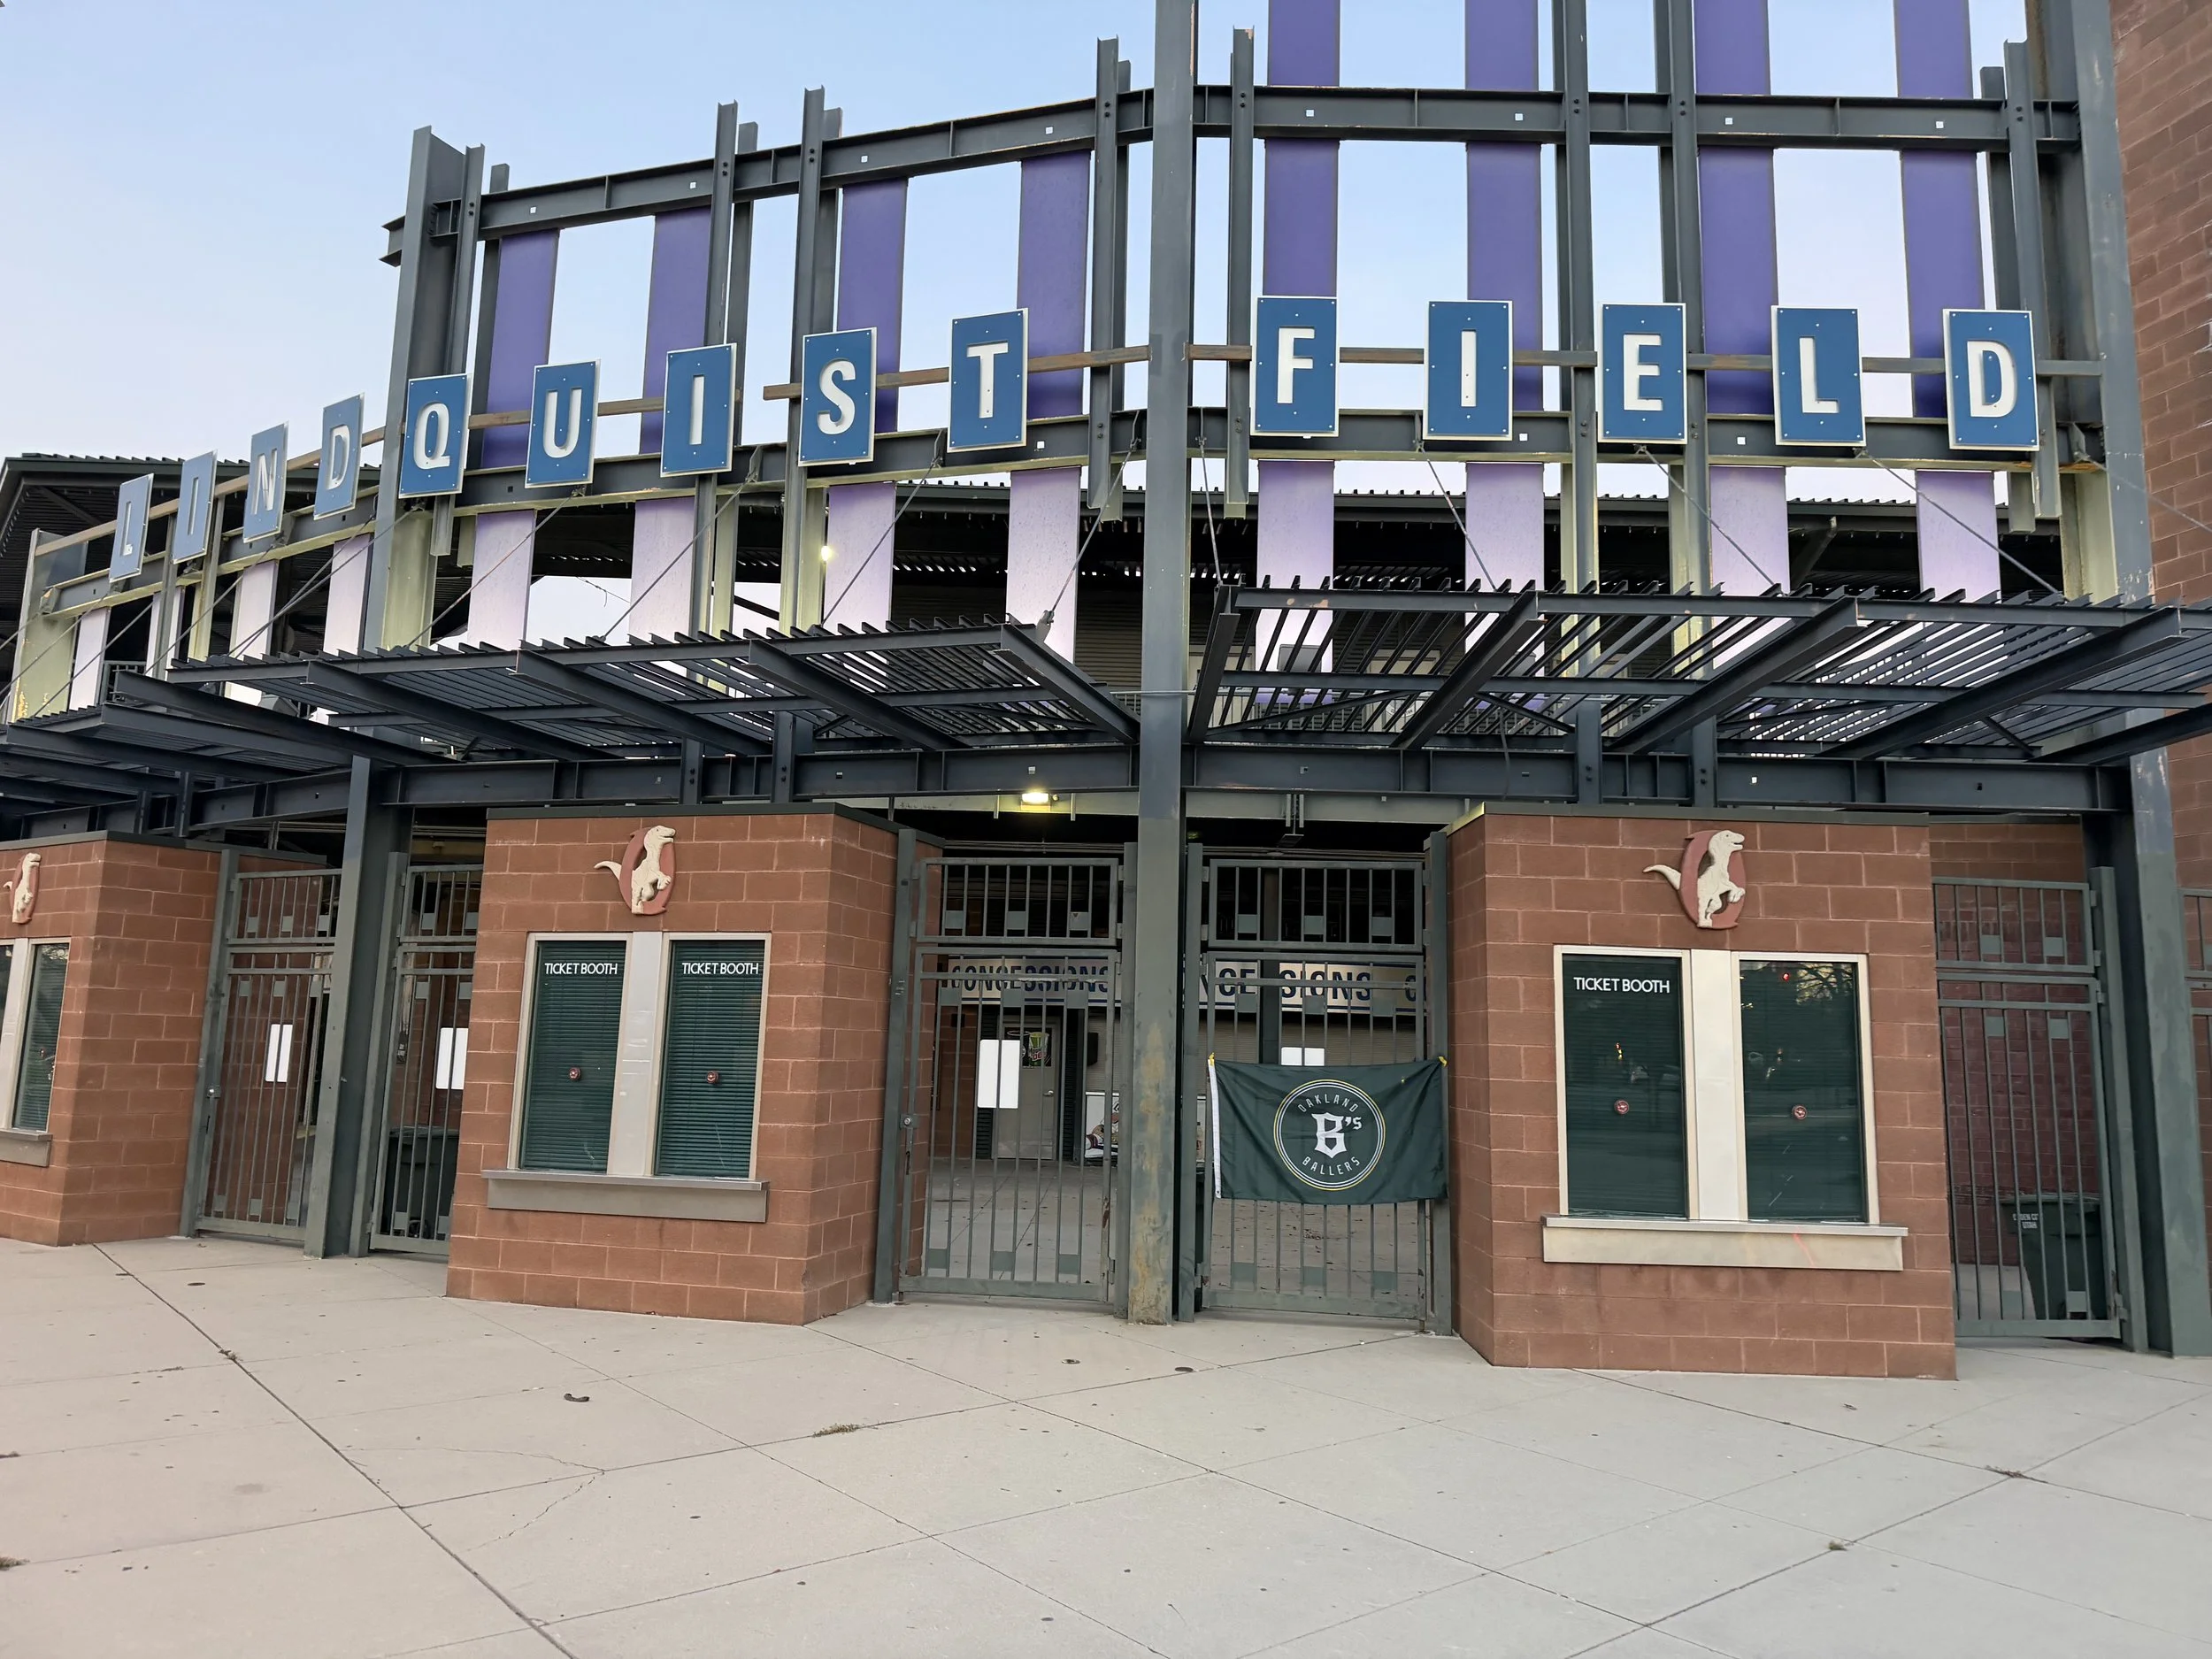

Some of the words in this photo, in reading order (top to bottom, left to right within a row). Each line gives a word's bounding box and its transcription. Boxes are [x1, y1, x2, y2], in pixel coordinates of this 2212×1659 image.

[121, 341, 1009, 557] LINDQUIST
[1277, 326, 2018, 419] FIELD
[544, 963, 580, 976] TICKET
[580, 963, 618, 975] BOOTH
[681, 962, 719, 975] TICKET
[720, 963, 759, 975] BOOTH
[1573, 977, 1620, 992] TICKET
[1622, 979, 1671, 994] BOOTH
[1297, 1094, 1359, 1113] OAKLAND
[1302, 1156, 1361, 1176] BALLERS
